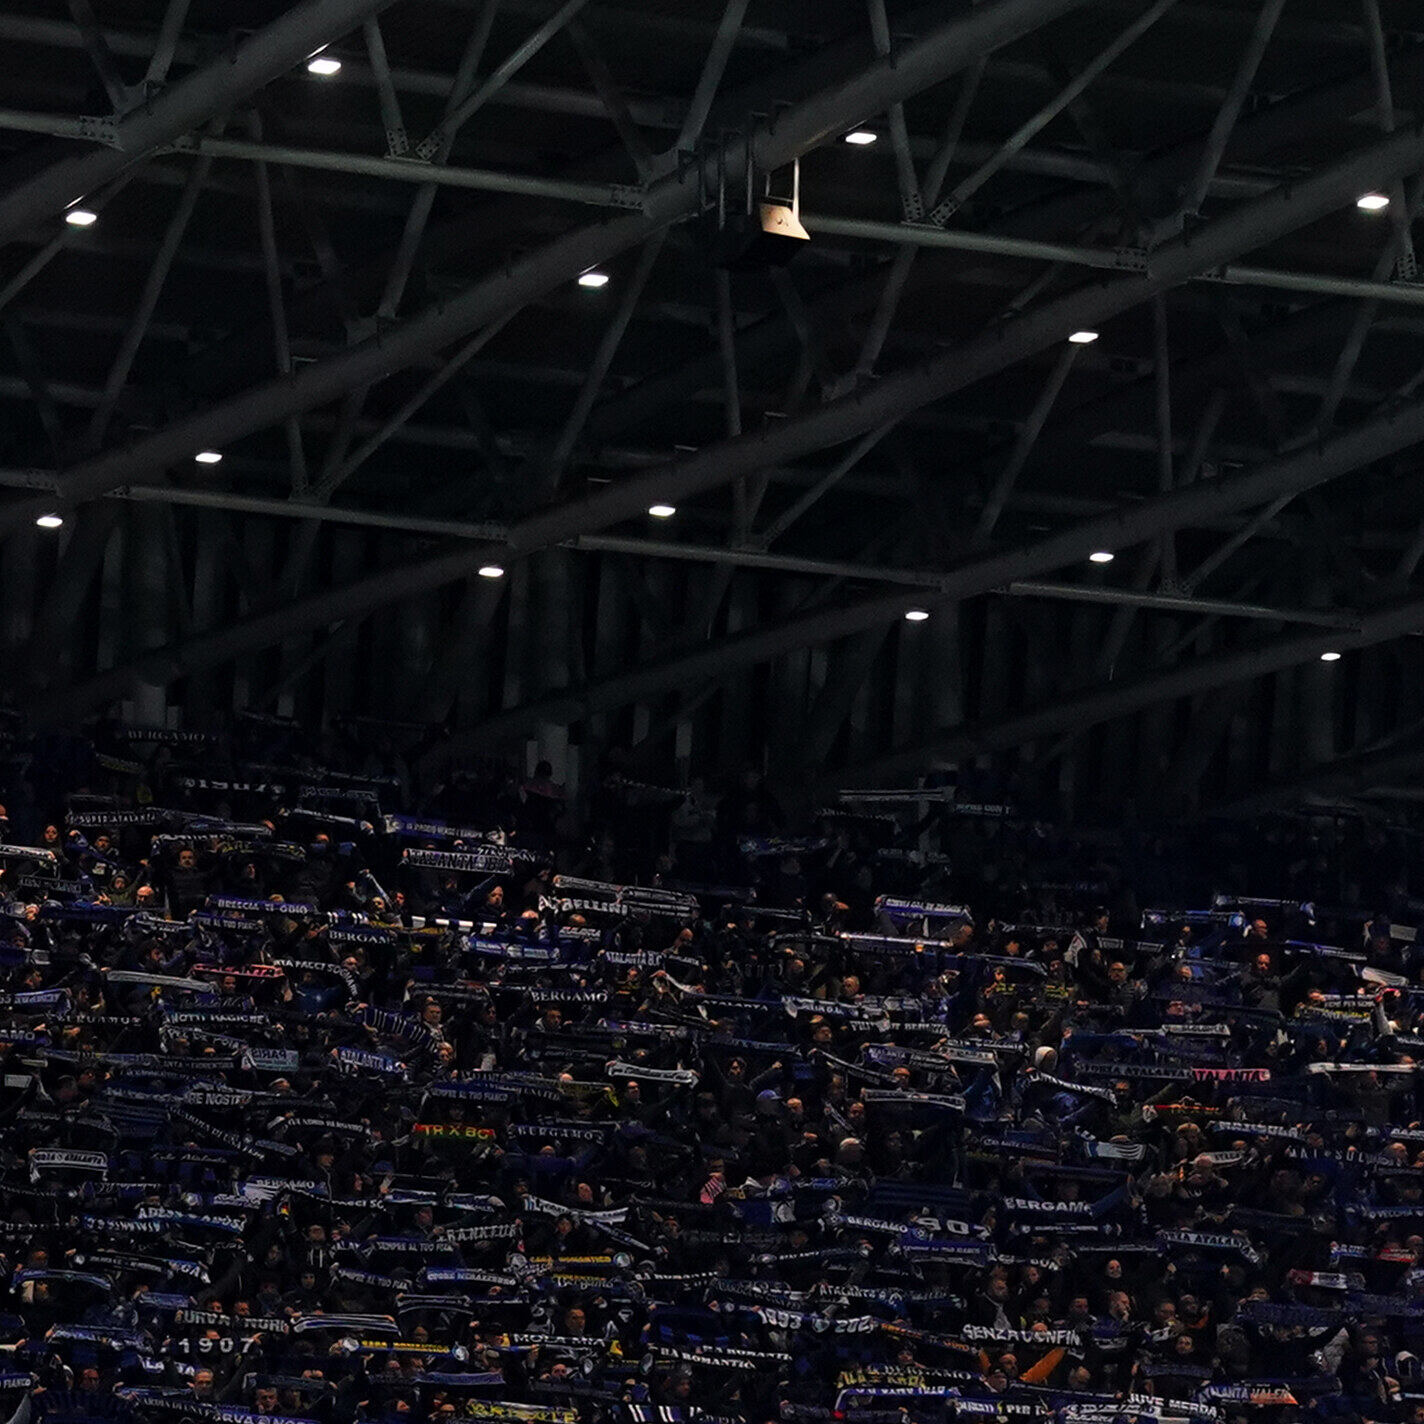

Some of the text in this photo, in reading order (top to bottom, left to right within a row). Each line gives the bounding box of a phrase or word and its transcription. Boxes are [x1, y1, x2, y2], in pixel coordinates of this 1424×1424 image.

[531, 990, 608, 1003] BERGAMO
[848, 1217, 909, 1233] BERGAMO
[3, 1379, 31, 1390] FIANCO
[1127, 1393, 1218, 1418] JUVE MERDA
